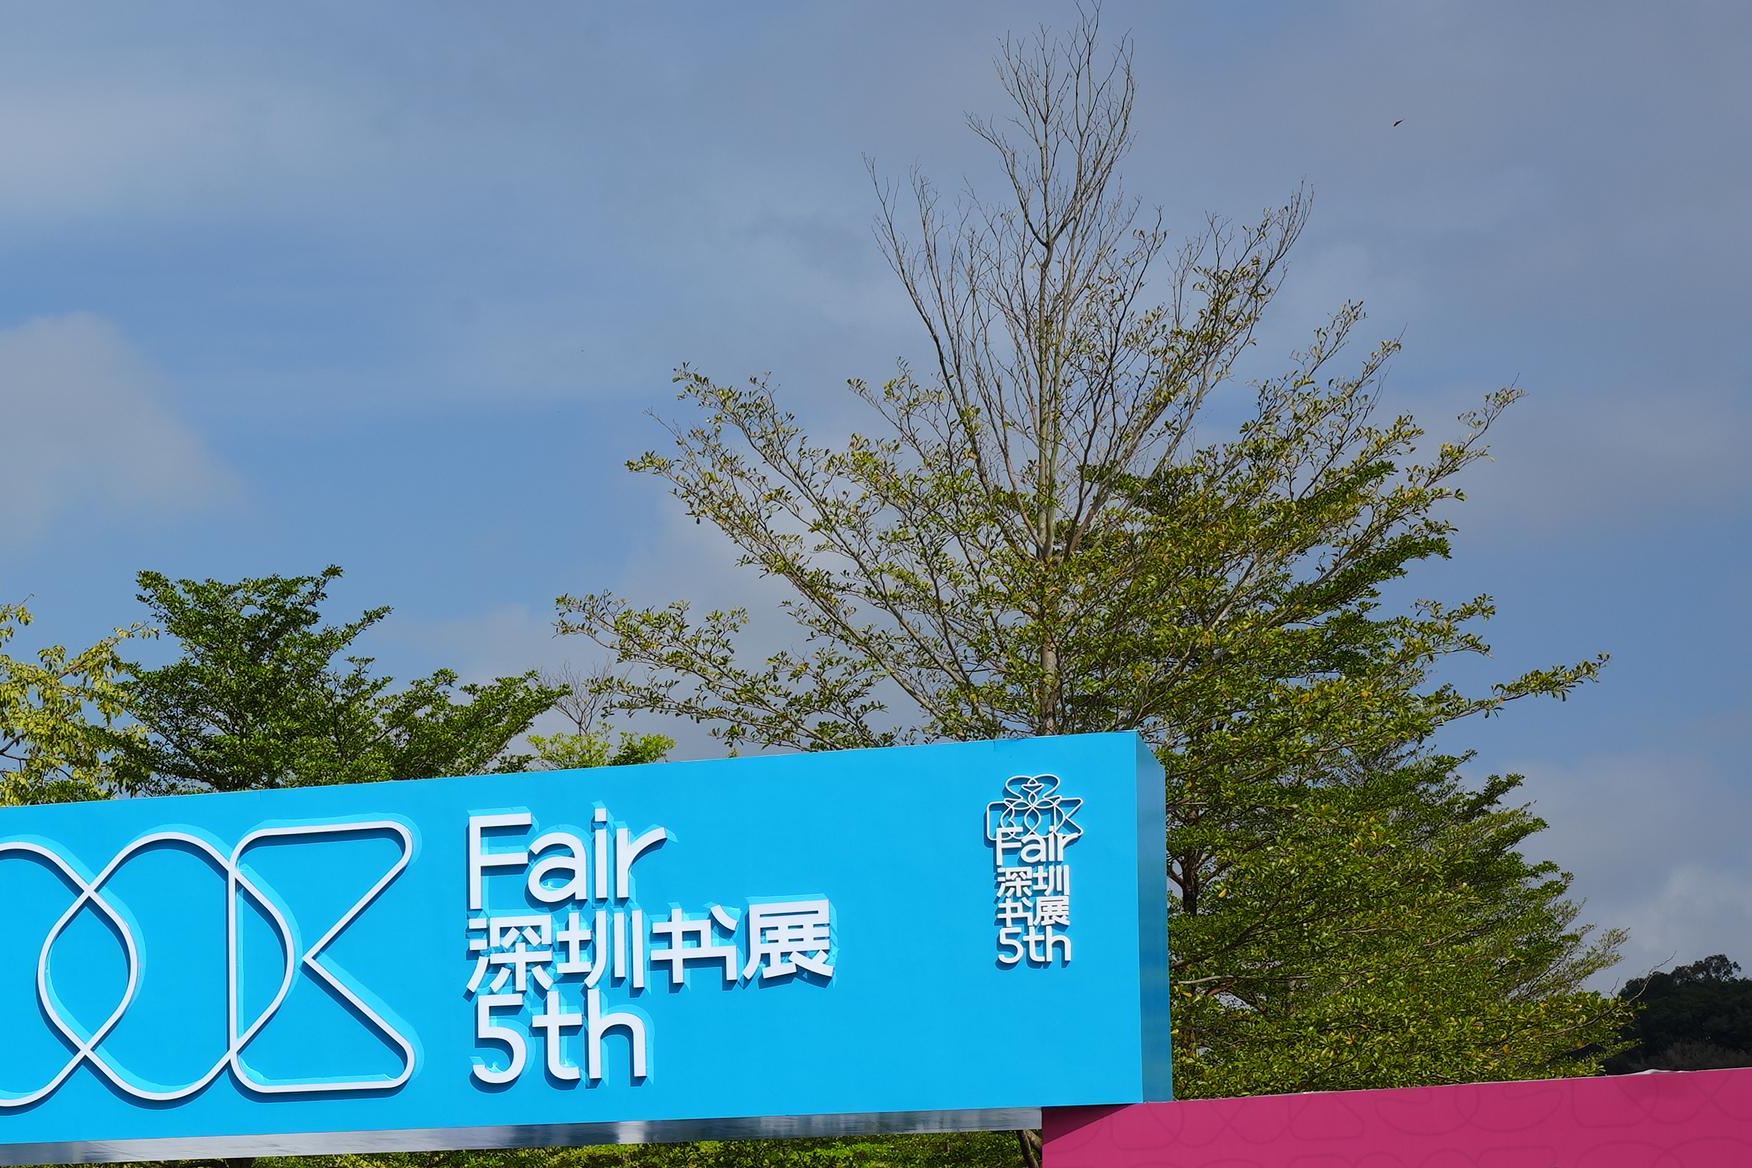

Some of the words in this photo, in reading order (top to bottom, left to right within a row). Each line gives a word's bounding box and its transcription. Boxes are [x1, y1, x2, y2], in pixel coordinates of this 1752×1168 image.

[468, 808, 666, 910] Fair
[996, 826, 1079, 866] Fair
[997, 865, 1071, 898] 深圳
[997, 896, 1071, 927] 书展
[467, 900, 834, 992] 深圳书展
[998, 926, 1072, 964] 5th
[470, 989, 648, 1084] 5th
